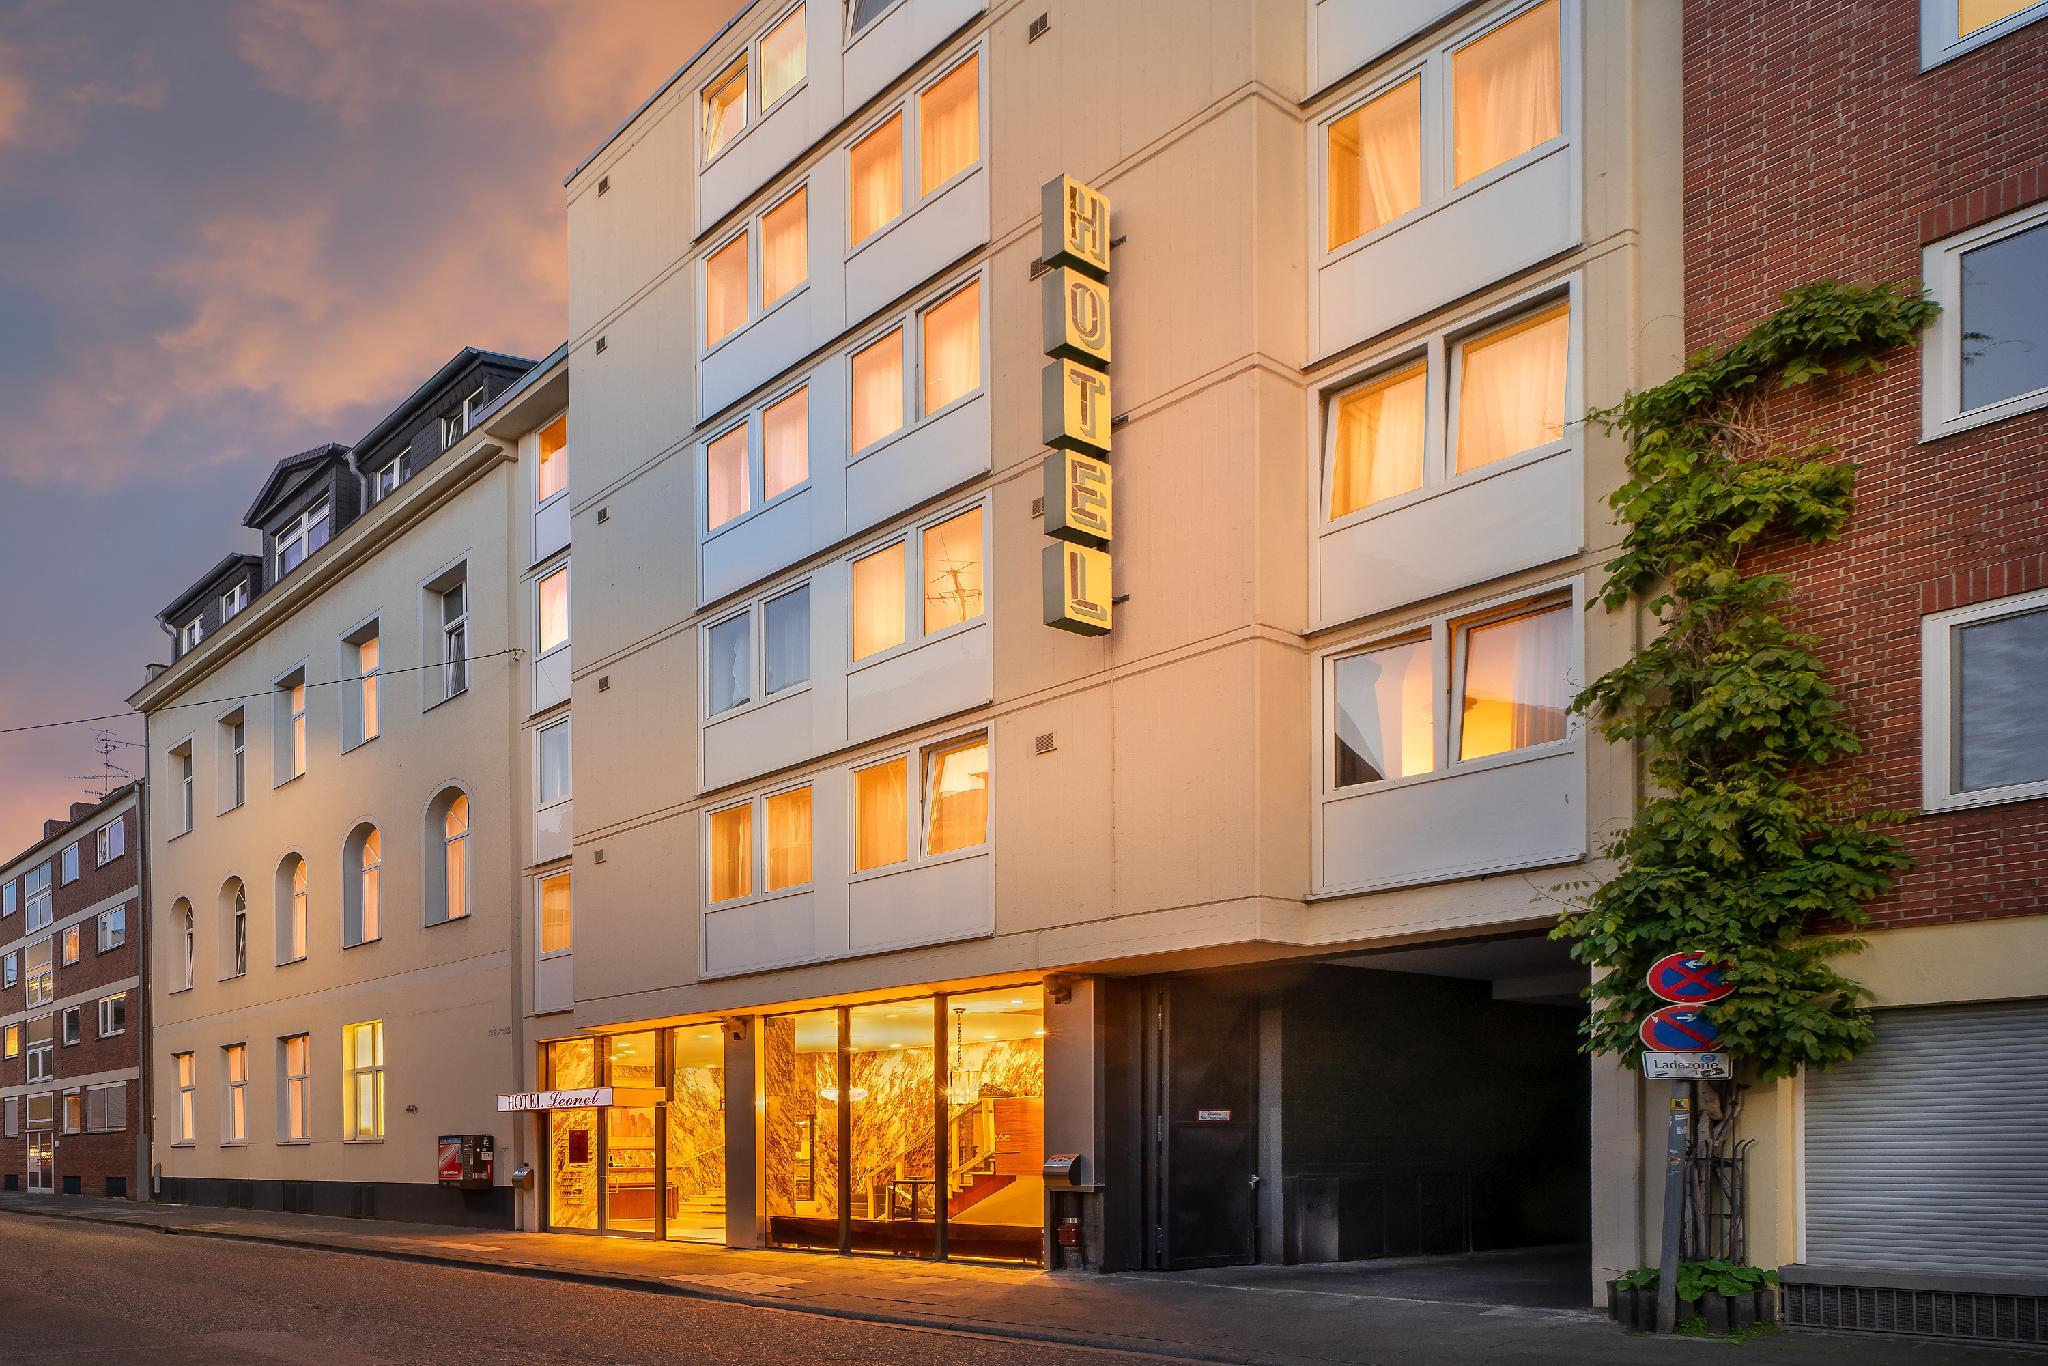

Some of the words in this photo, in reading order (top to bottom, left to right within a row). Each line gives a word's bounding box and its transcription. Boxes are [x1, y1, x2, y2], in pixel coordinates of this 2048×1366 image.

[1068, 184, 1107, 622] HOTEL
[1654, 1060, 1719, 1069] Ladezone
[508, 1094, 544, 1110] HOTEL
